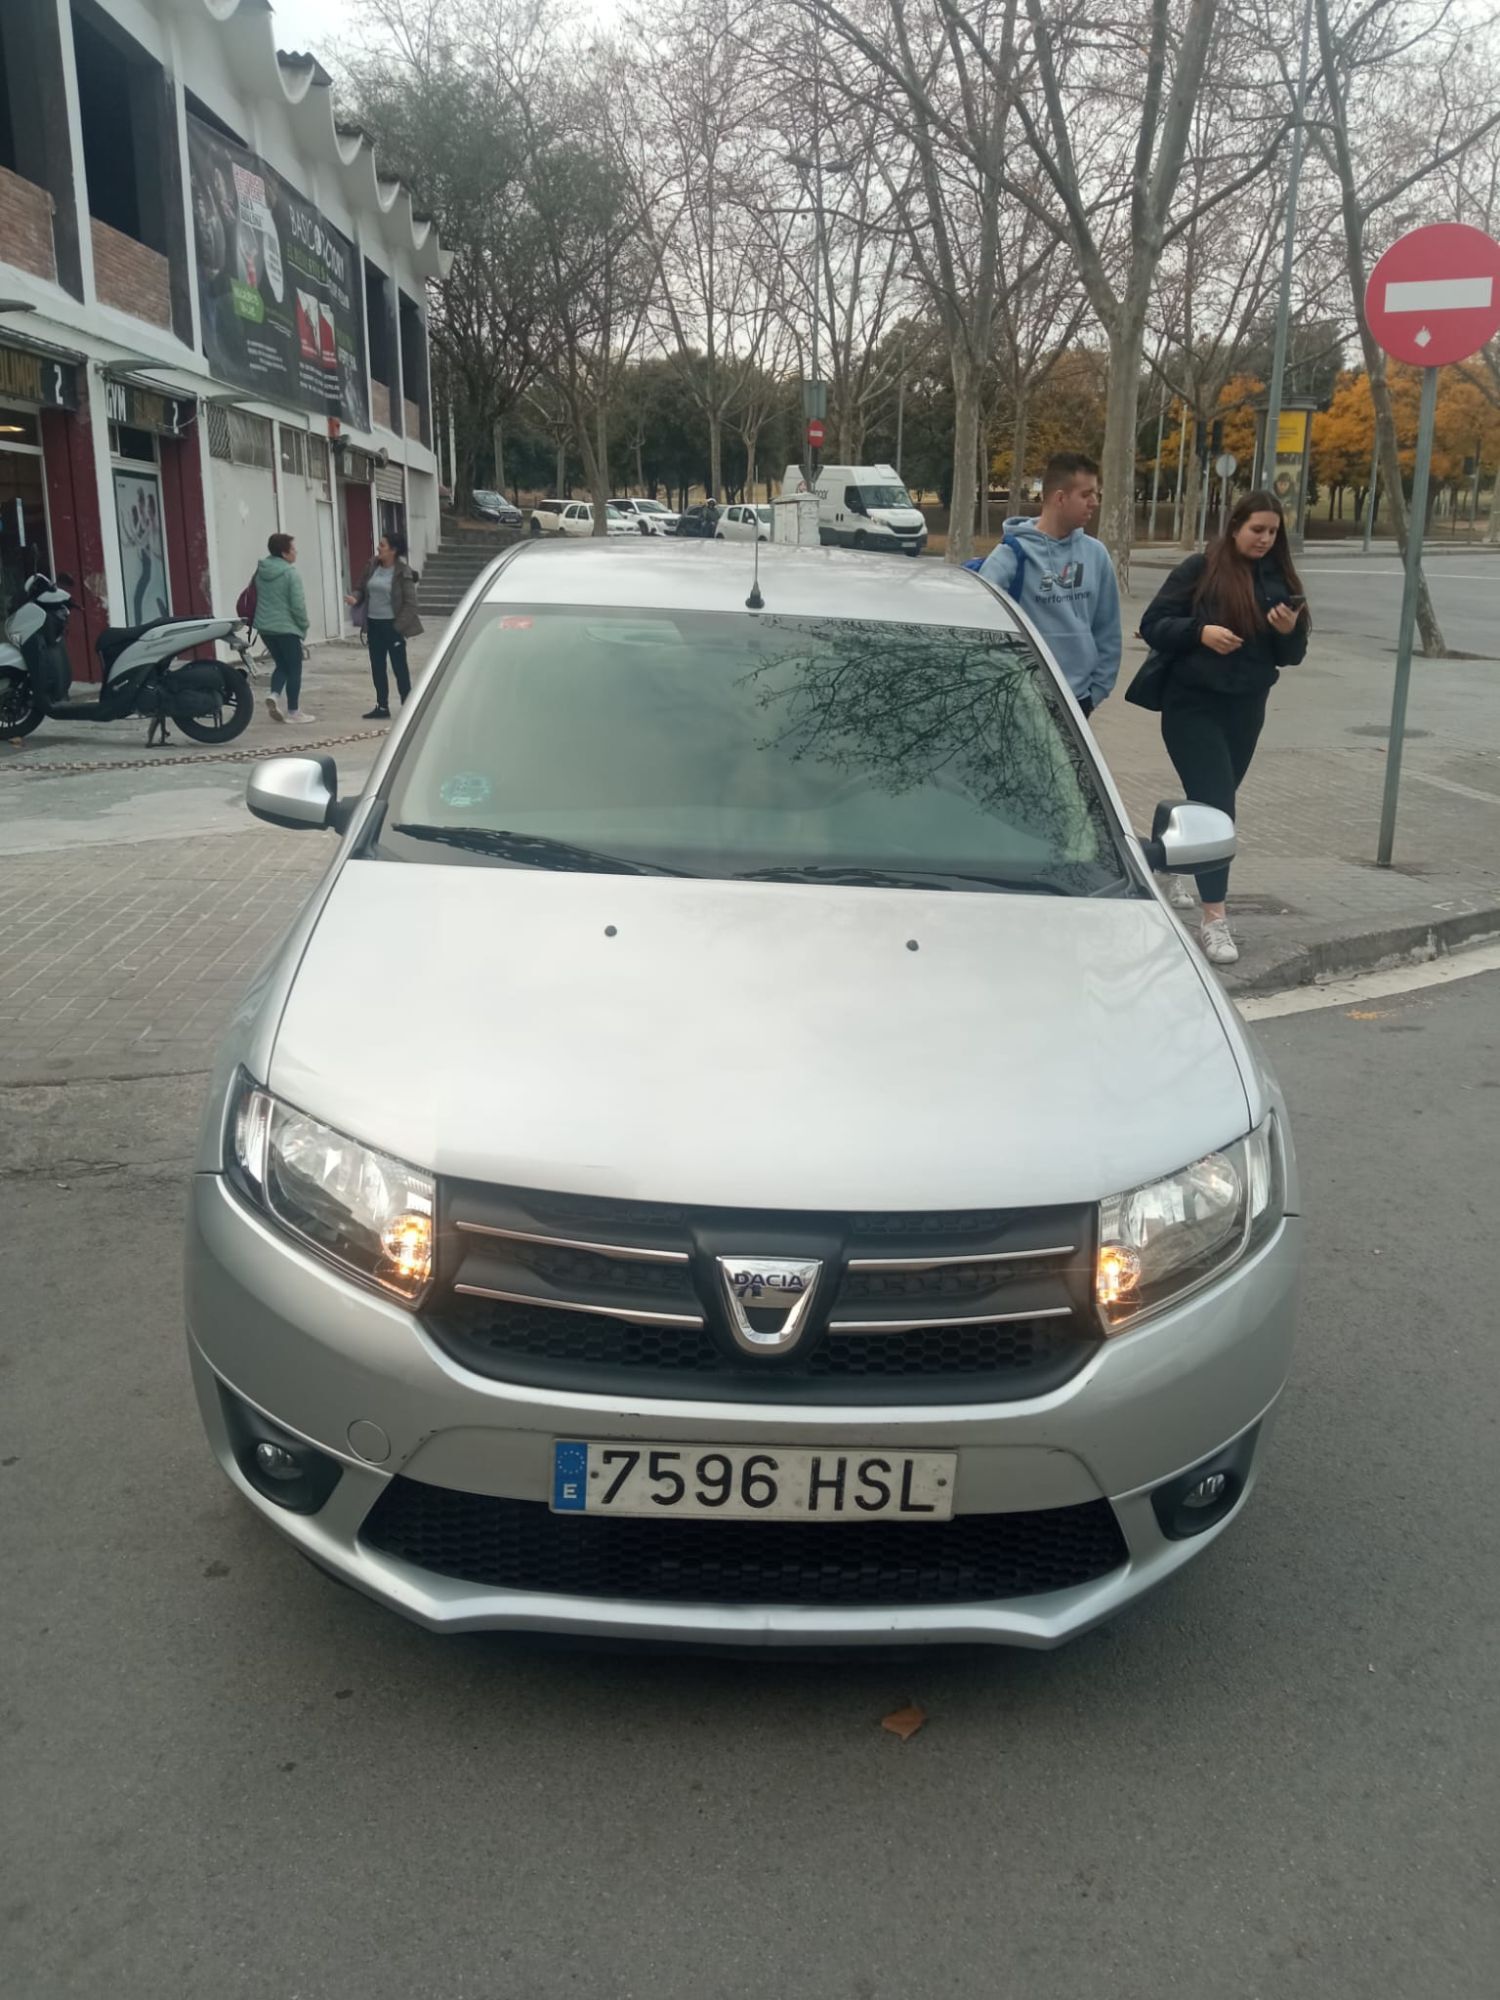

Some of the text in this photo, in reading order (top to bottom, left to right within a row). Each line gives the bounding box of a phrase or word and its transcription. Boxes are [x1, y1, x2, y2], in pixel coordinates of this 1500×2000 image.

[53, 363, 63, 405] 2
[105, 383, 127, 423] GYM
[734, 1273, 804, 1288] DACIA
[562, 1450, 936, 1513] E 7596 HSL
